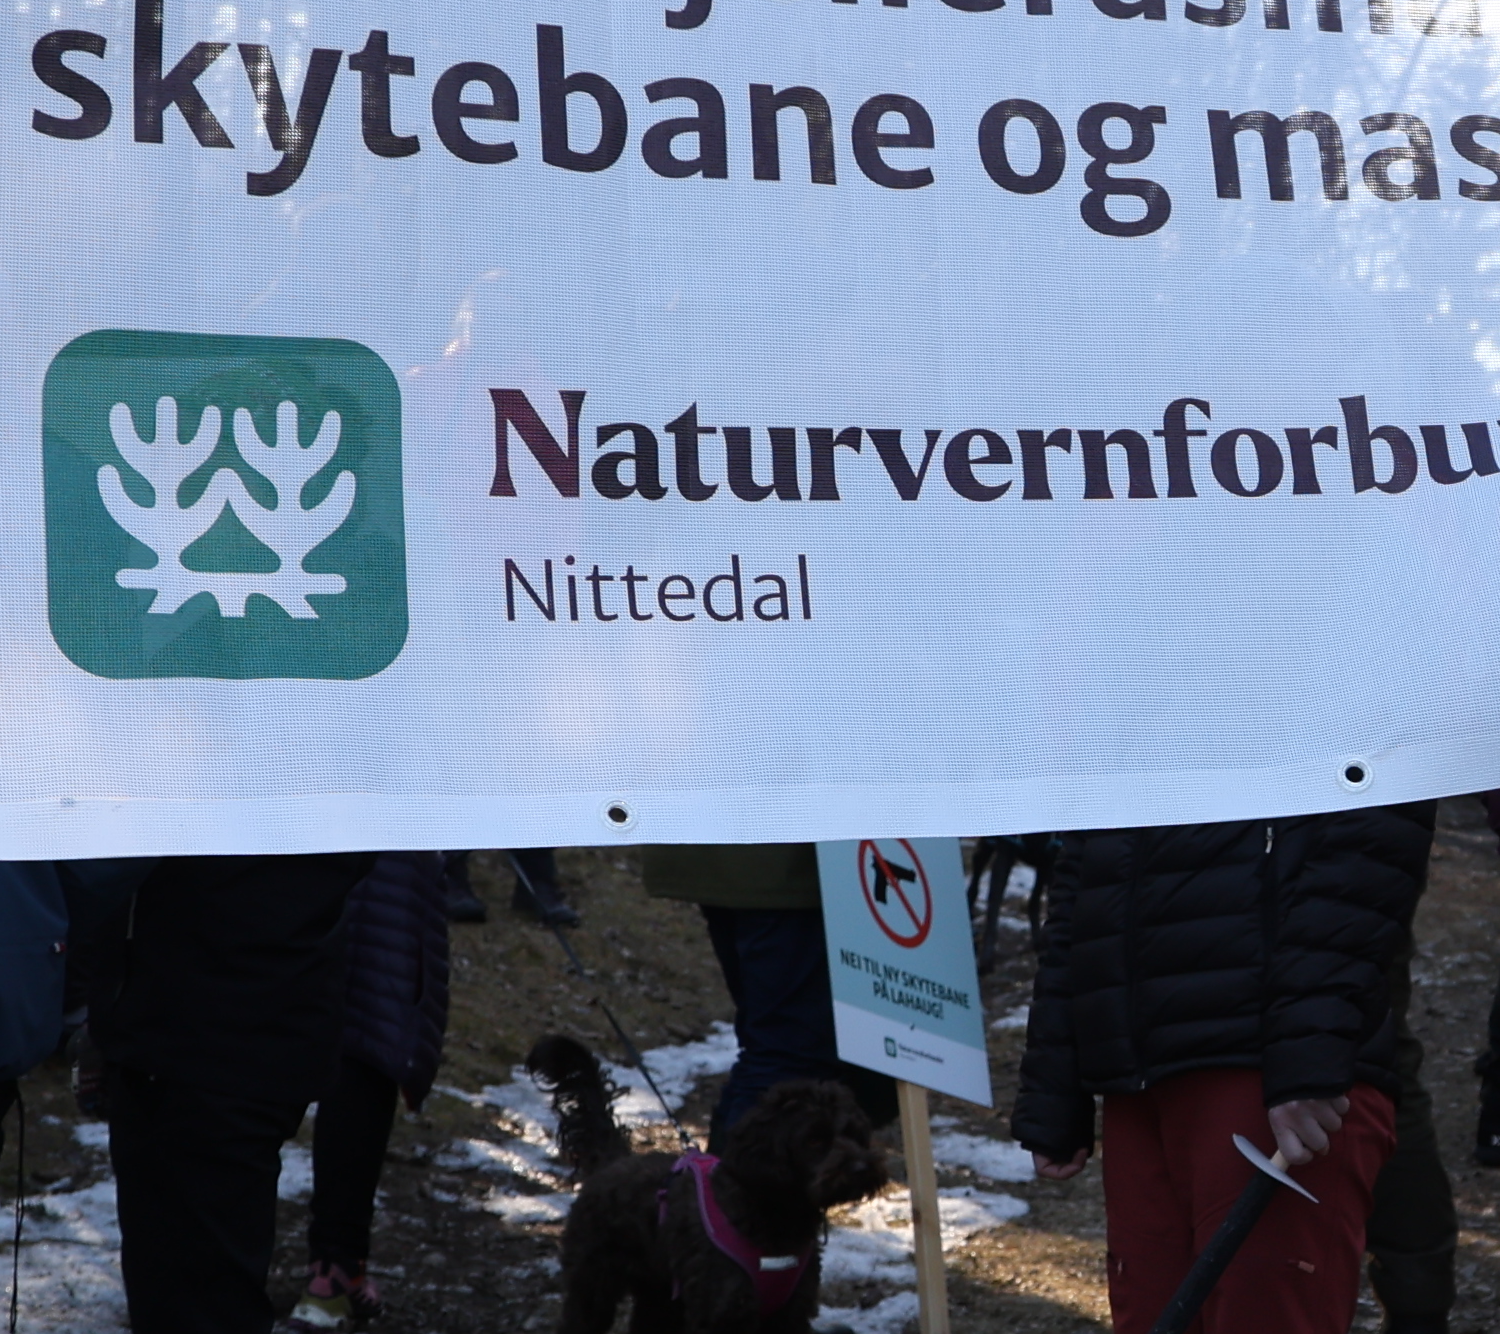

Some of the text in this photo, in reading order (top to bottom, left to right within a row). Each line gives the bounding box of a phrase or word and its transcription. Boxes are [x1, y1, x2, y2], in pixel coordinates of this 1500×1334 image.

[977, 96, 1173, 238] og
[500, 555, 814, 625] Nittedal
[840, 948, 970, 1009] NEI TIL NY SKYTEBANE
[873, 978, 890, 1002] PÅ
